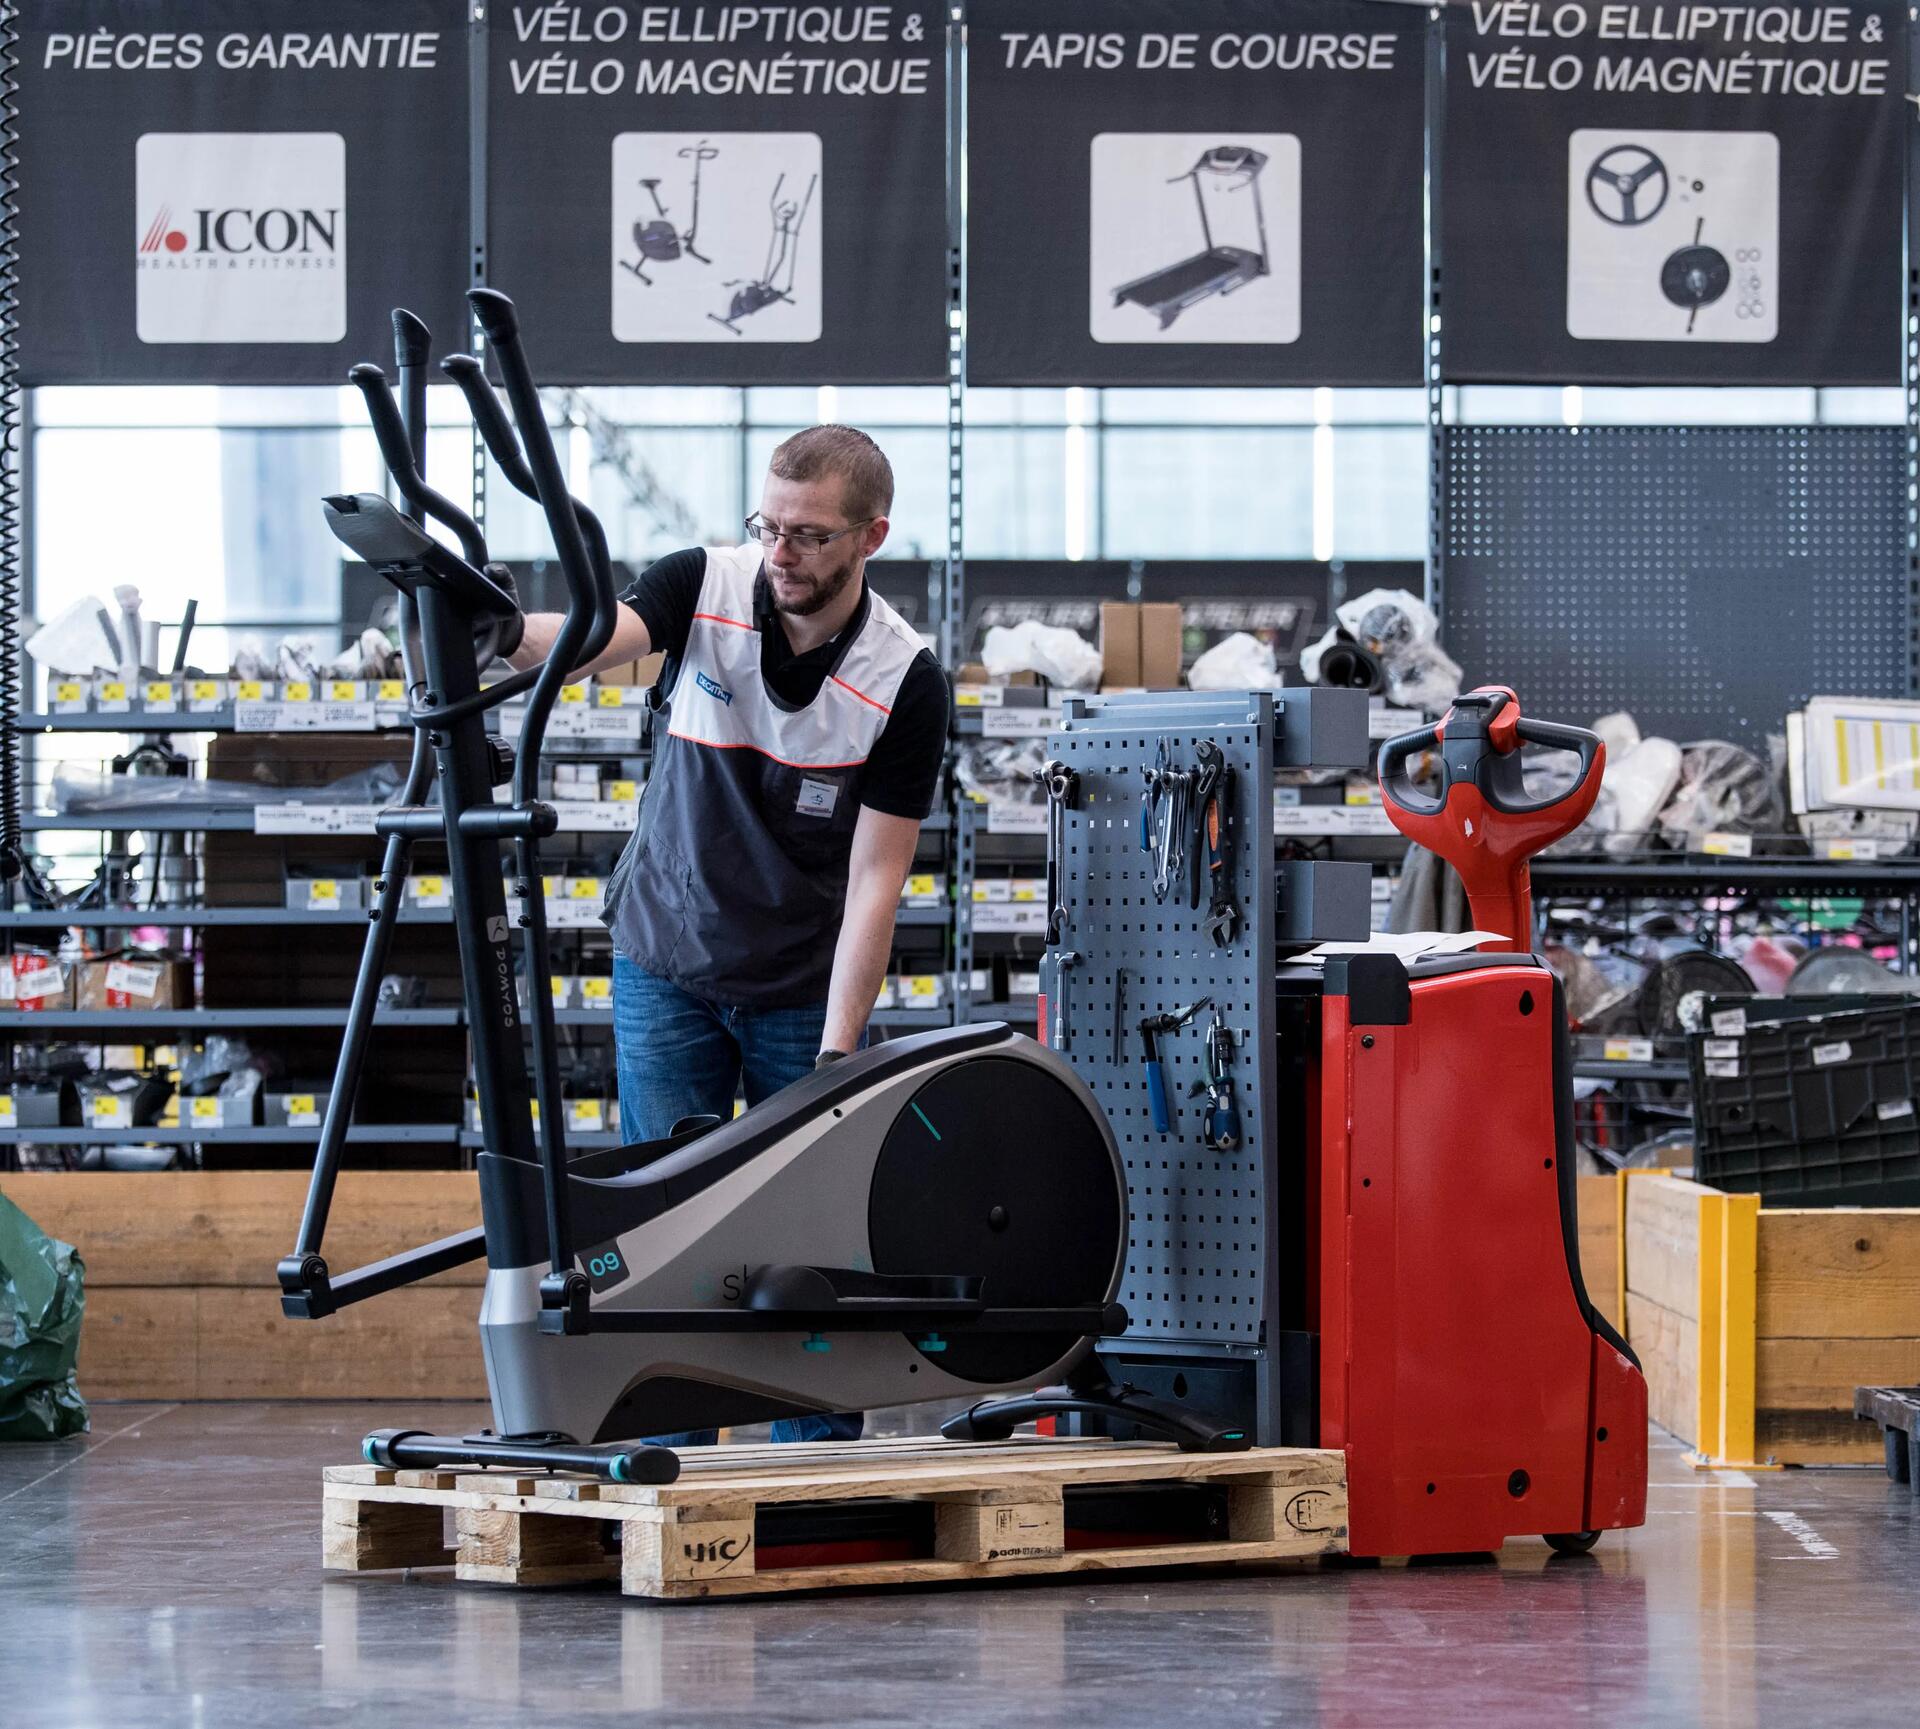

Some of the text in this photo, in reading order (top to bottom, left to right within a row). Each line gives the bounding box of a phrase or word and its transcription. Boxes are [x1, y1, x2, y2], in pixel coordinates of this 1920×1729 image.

[514, 4, 923, 43] VÉLO ELLIPTIQUE &
[1471, 2, 1882, 43] VÉLO ELLIPTIQUE &
[44, 27, 439, 70] PIÈCES GARANTIE
[1001, 34, 1397, 70] TAPIS DE COURSE
[509, 52, 930, 95] VÉLO MAGNÉTIQUE
[1467, 48, 1888, 95] VÉLO MAGNÉTIQUE
[194, 208, 339, 254] ICON
[137, 258, 218, 269] HEALTH
[248, 257, 336, 269] FITNESS
[496, 947, 515, 1028] DOMYOS
[589, 1251, 620, 1277] 09
